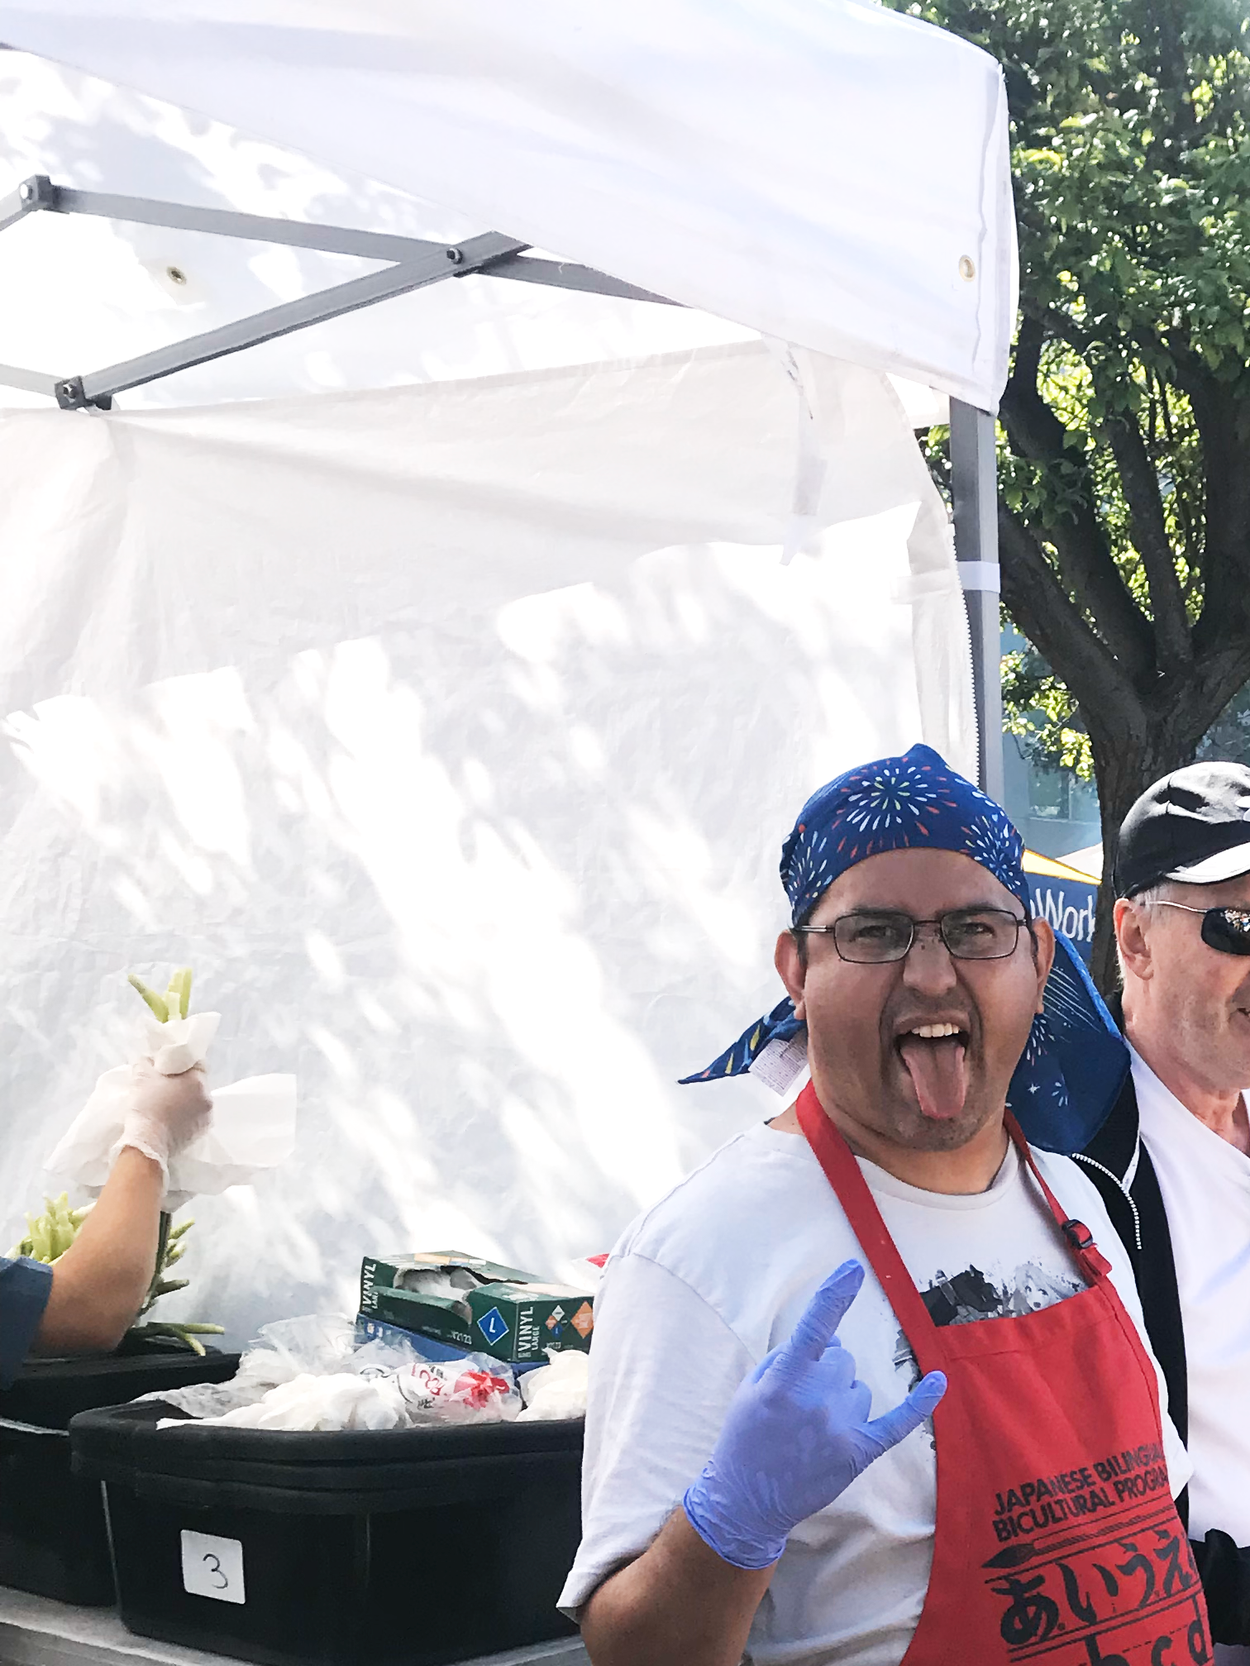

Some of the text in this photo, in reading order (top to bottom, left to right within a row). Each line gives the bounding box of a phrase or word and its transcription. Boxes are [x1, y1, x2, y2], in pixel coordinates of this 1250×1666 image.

[518, 1306, 534, 1352] VINYL
[531, 1326, 540, 1351] LARGE
[992, 1487, 1115, 1542] BICULTURAL
[994, 1467, 1096, 1516] JAPANESE
[203, 1553, 229, 1590] 3
[991, 1530, 1199, 1645] あいうえ
